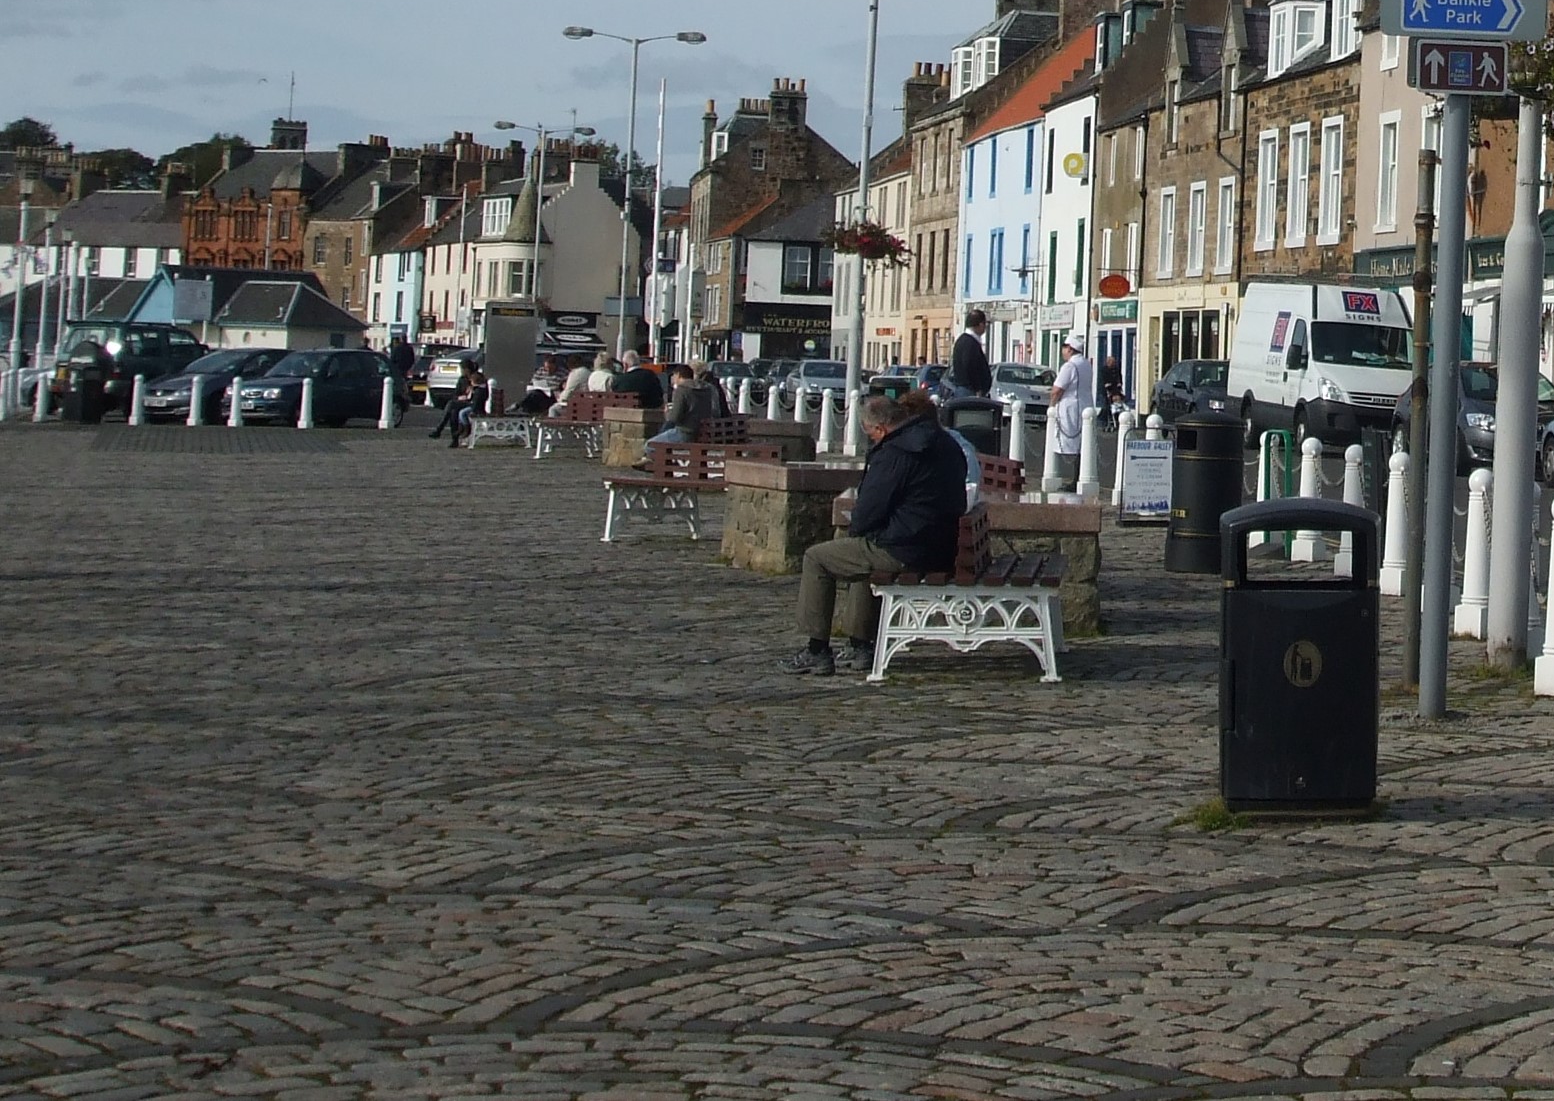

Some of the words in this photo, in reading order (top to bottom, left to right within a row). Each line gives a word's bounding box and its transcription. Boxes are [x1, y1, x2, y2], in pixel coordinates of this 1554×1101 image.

[1445, 9, 1482, 25] Park
[1346, 293, 1378, 311] FX
[762, 318, 830, 329] WATERFRO
[1345, 313, 1382, 323] SIGNS
[1127, 441, 1151, 450] HARBOUR
[1154, 441, 1172, 451] GALLEY
